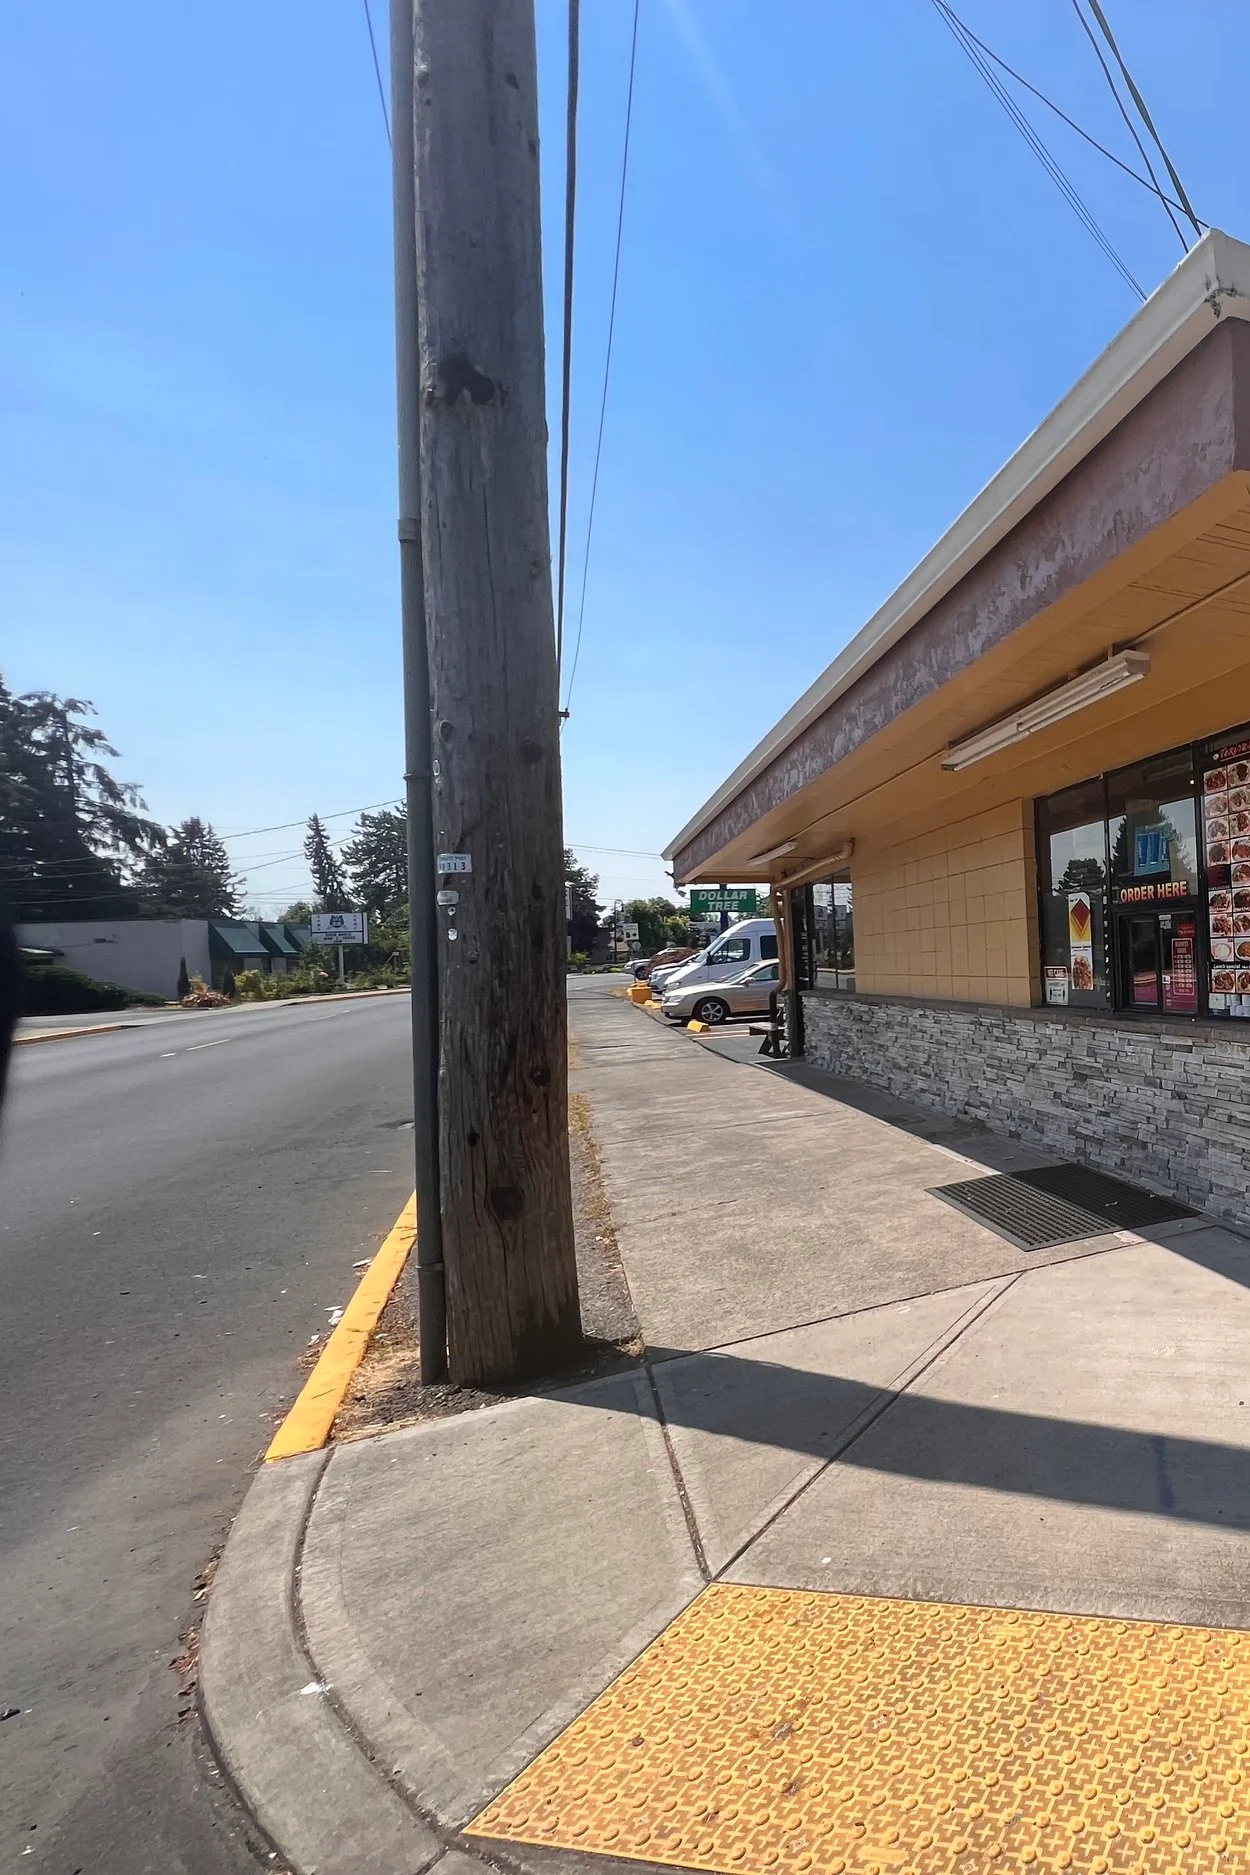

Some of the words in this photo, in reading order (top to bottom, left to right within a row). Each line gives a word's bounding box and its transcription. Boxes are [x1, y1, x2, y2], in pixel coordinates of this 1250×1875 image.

[698, 890, 748, 901] DOLLAR
[1120, 885, 1154, 903] ORDER
[1157, 881, 1187, 899] HERE
[707, 901, 739, 911] TREE
